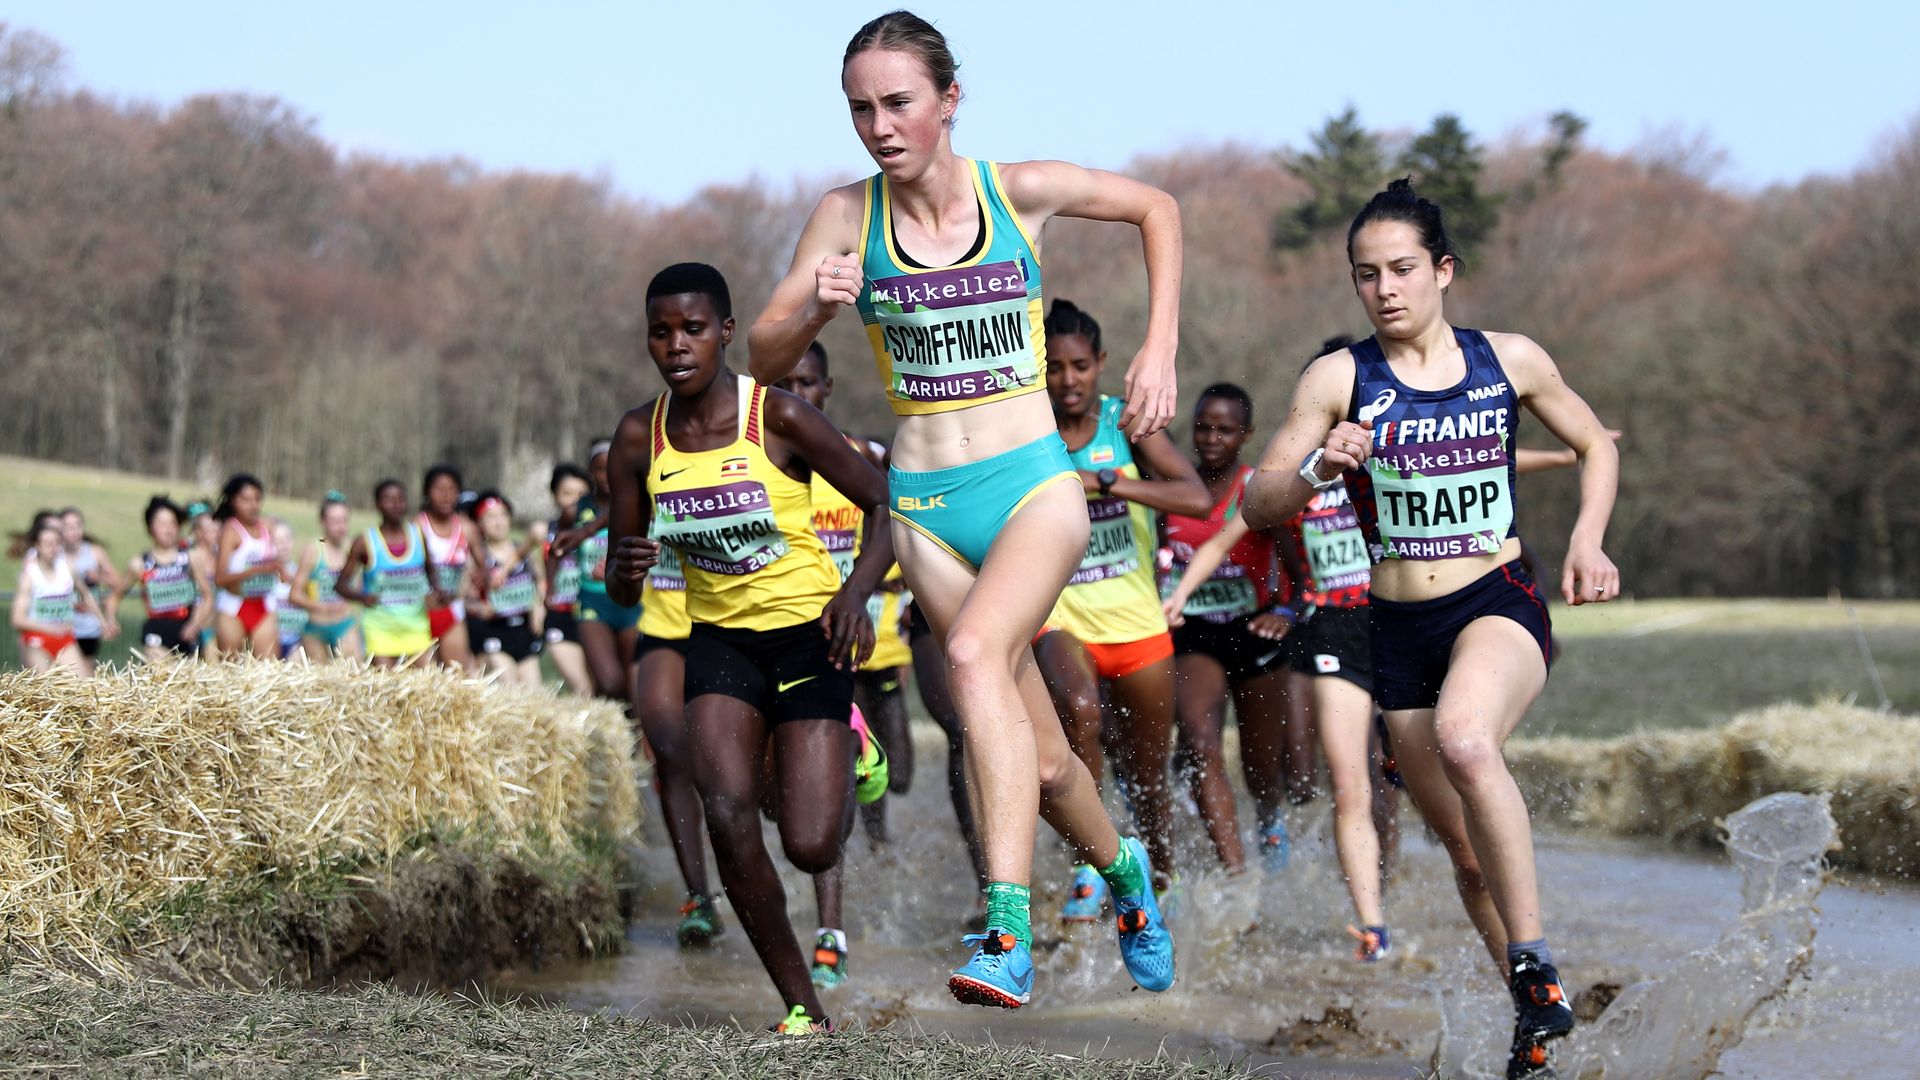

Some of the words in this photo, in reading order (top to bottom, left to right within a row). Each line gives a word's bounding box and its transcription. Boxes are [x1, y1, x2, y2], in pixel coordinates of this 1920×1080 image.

[874, 274, 1019, 304] Mikkeller
[886, 311, 1025, 365] SCHIFFMANN
[899, 378, 976, 397] AARHUS
[1467, 382, 1507, 402] MAIF
[1398, 408, 1508, 445] FRANCE
[1375, 446, 1501, 471] Mikkeller
[657, 487, 765, 517] Mikkeller
[897, 495, 947, 510] BLK
[1382, 481, 1500, 527] TRAPP
[688, 555, 745, 574] AARHUS
[748, 541, 785, 571] 2019
[1388, 540, 1462, 557] AARHUS
